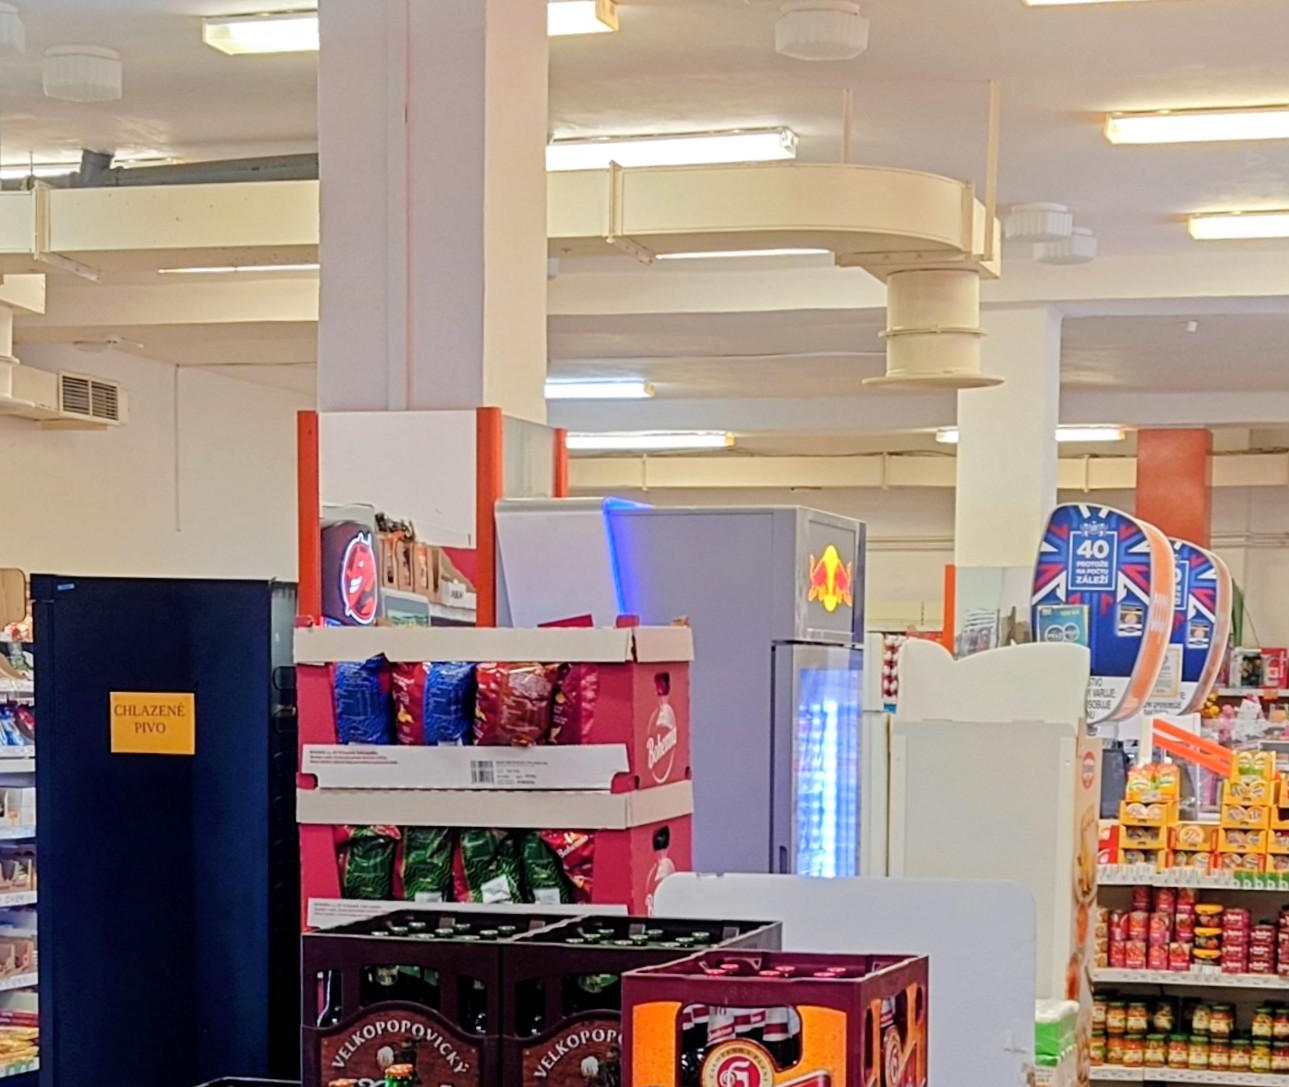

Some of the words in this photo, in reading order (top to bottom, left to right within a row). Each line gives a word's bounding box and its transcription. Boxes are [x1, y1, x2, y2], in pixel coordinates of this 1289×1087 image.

[1076, 541, 1110, 560] 40
[1076, 573, 1109, 585] ZÁLEŽÍ
[113, 702, 186, 719] CHLAZENÉ
[134, 720, 167, 735] PIVO
